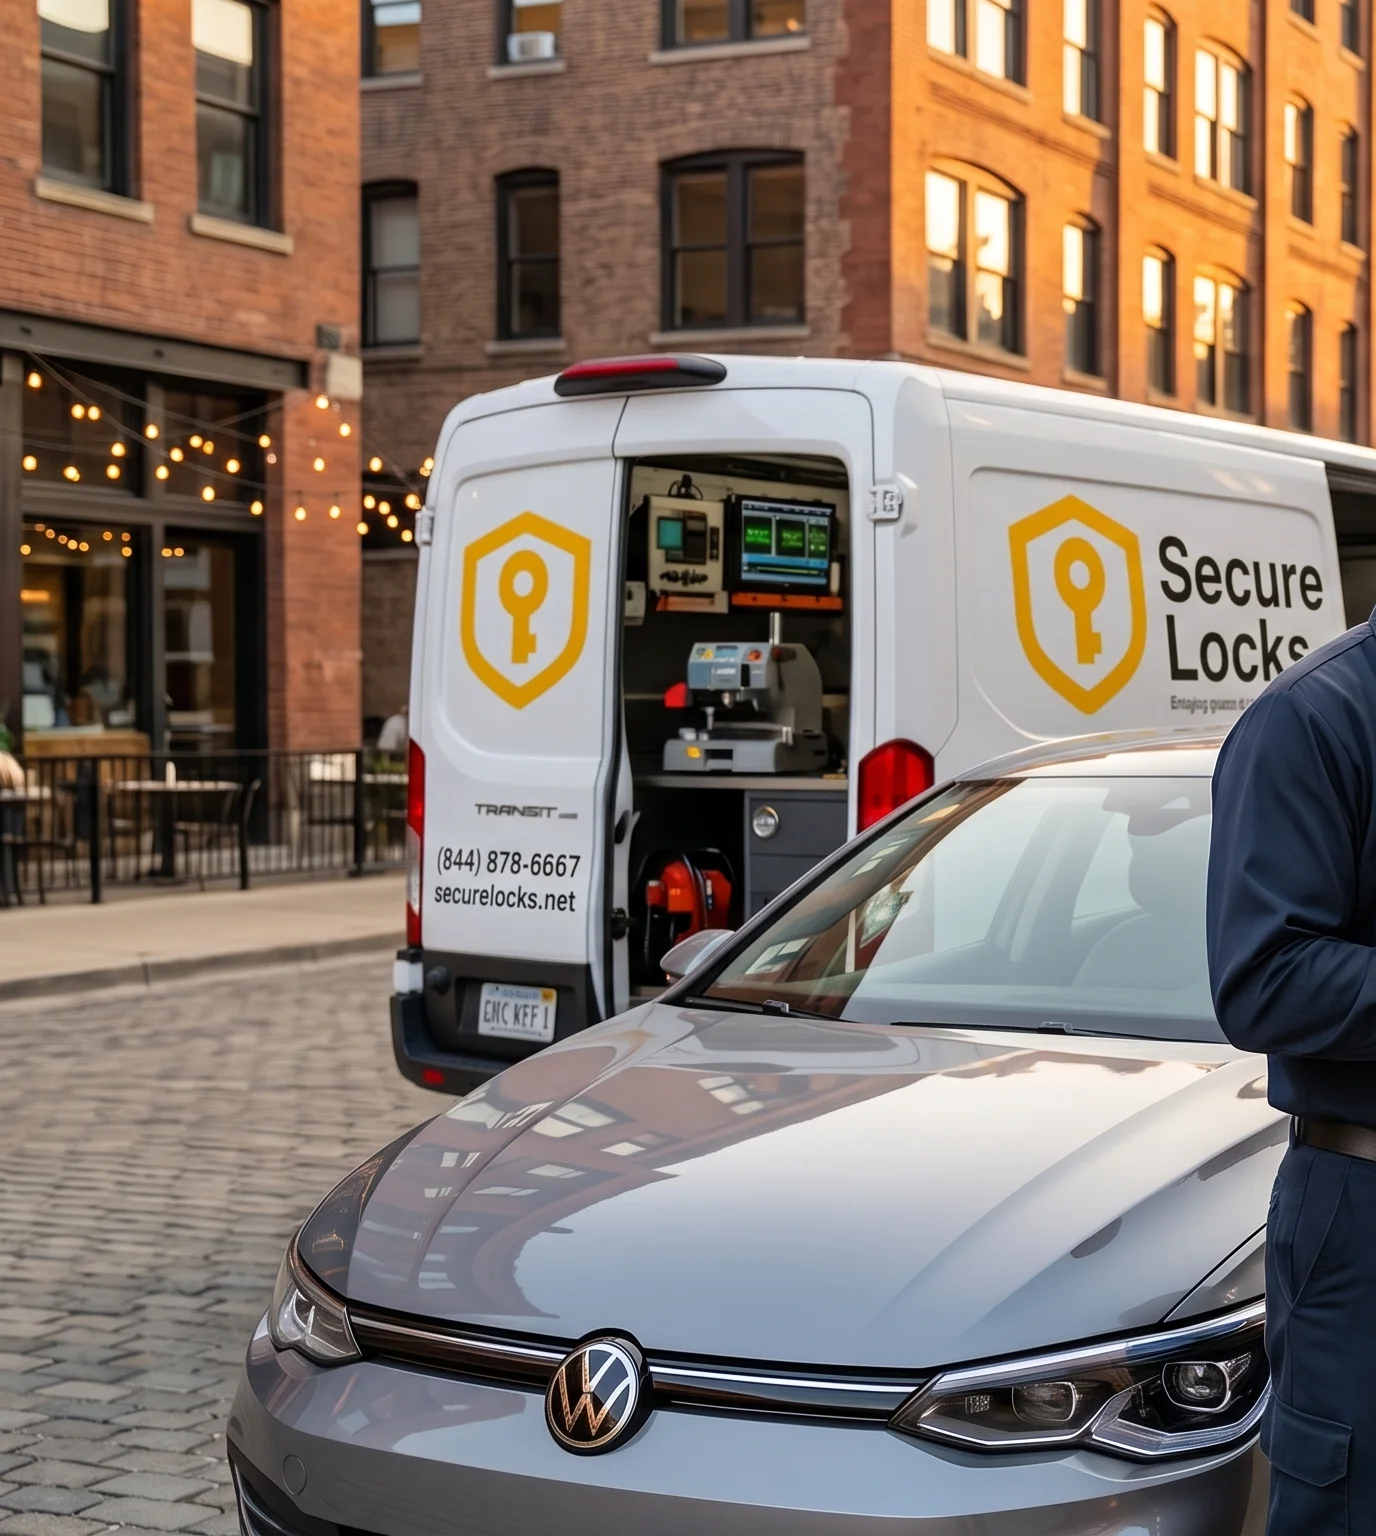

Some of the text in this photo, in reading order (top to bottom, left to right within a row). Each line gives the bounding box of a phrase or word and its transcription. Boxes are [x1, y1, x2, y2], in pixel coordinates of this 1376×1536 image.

[1158, 536, 1323, 611] Secure
[475, 803, 557, 818] TRANSIT
[437, 846, 581, 877] (844) 878-6667
[434, 884, 576, 912] securelocks.net
